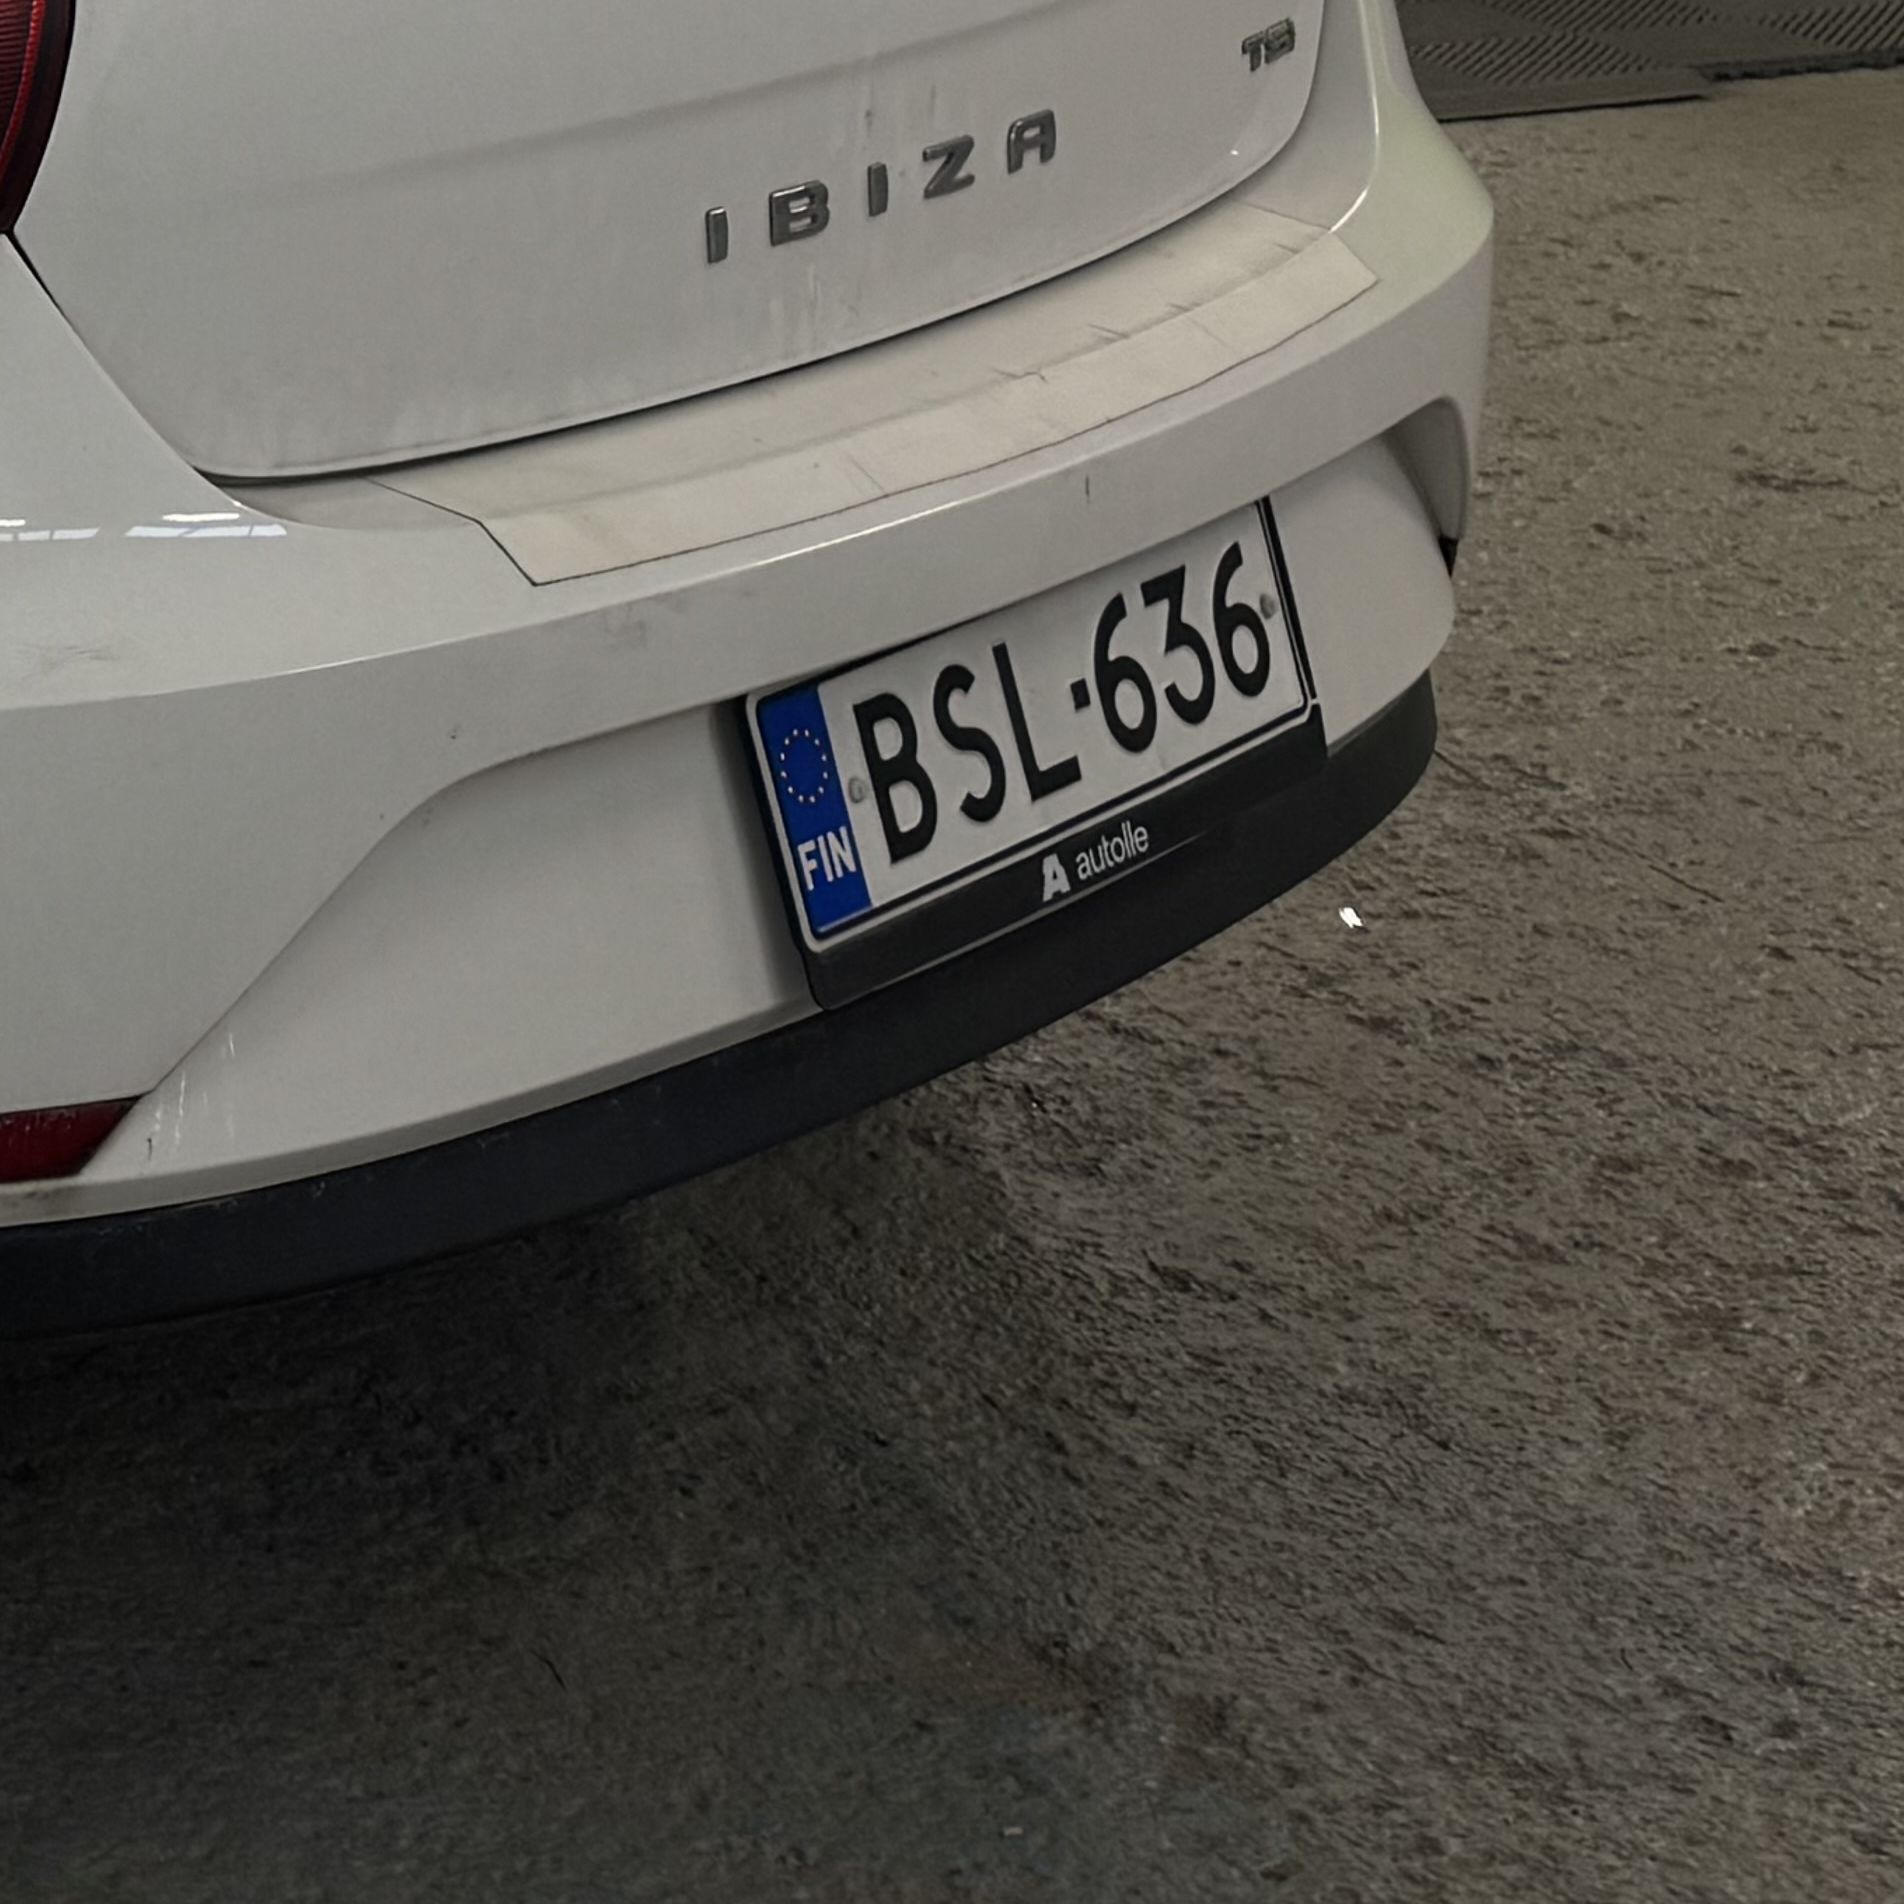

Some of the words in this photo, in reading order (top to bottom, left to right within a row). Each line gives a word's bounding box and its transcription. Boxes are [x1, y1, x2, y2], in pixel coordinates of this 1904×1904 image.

[704, 108, 1058, 265] IBIZA
[852, 540, 1272, 866] BSL-636
[796, 825, 858, 891] FIN
[1075, 820, 1150, 881] autolle
